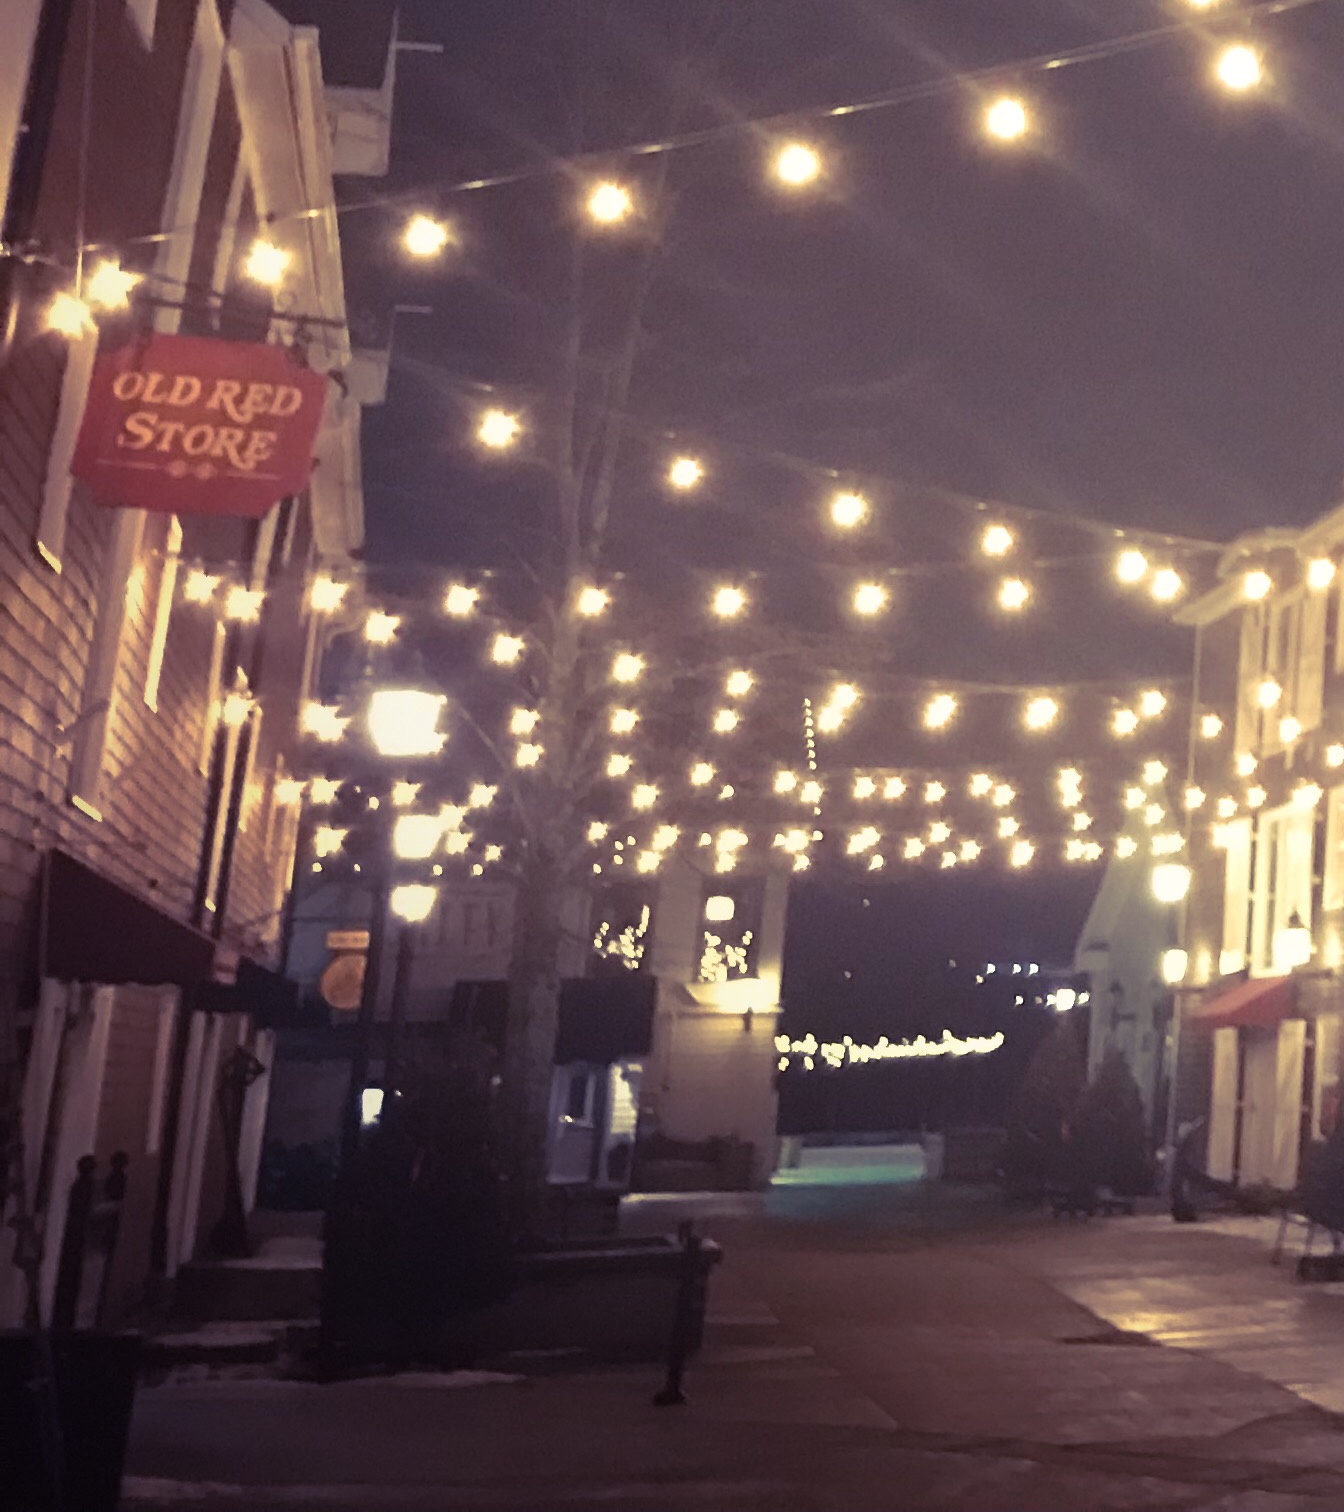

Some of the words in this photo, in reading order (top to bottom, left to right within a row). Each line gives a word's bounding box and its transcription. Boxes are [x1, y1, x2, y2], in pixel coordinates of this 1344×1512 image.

[113, 372, 200, 406] OLD
[206, 380, 303, 424] RED
[118, 412, 277, 470] STORE
